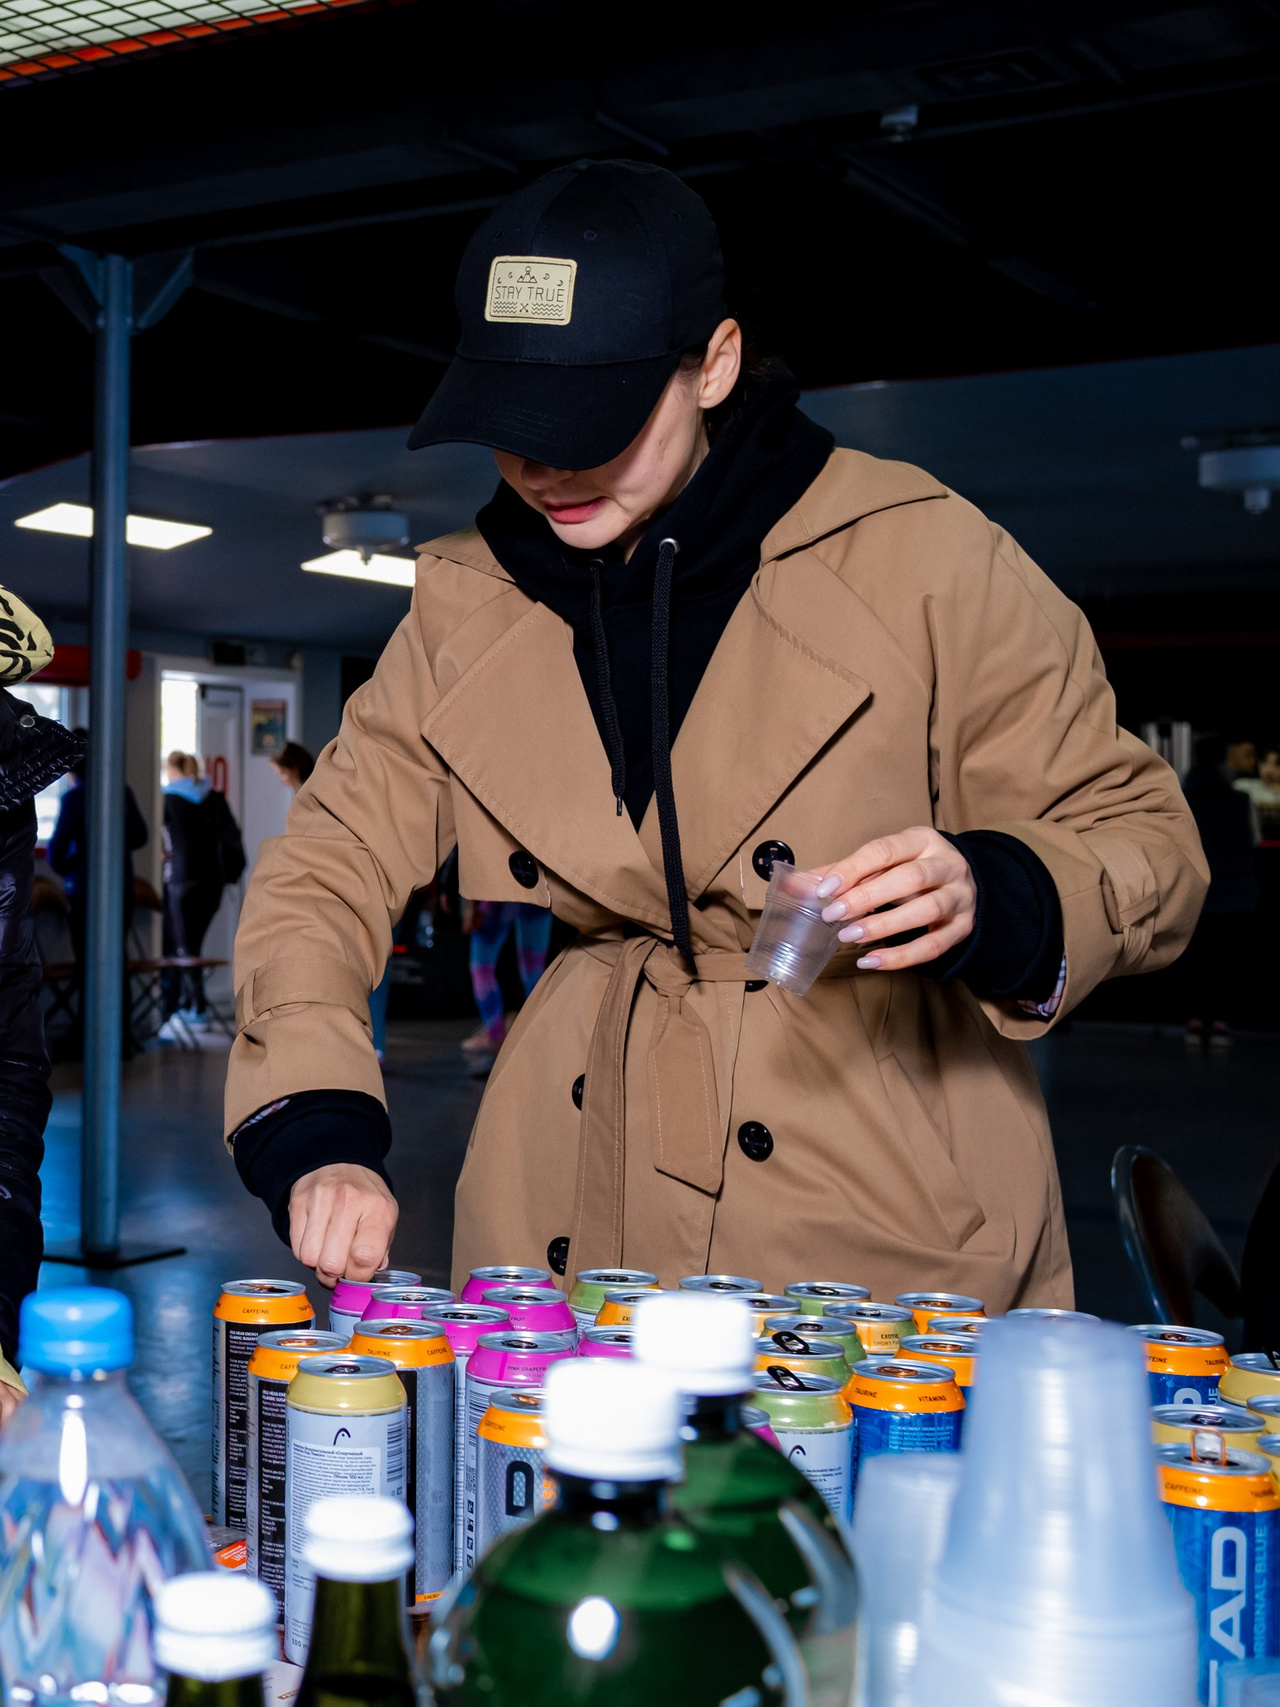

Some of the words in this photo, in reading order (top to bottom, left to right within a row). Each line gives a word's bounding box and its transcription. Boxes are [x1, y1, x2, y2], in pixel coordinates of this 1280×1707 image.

[495, 286, 522, 300] STAY
[527, 286, 565, 302] TRUE
[366, 1348, 391, 1357] TAURINE
[426, 1347, 448, 1356] CAFFEINE
[1255, 1526, 1268, 1574] BLUE
